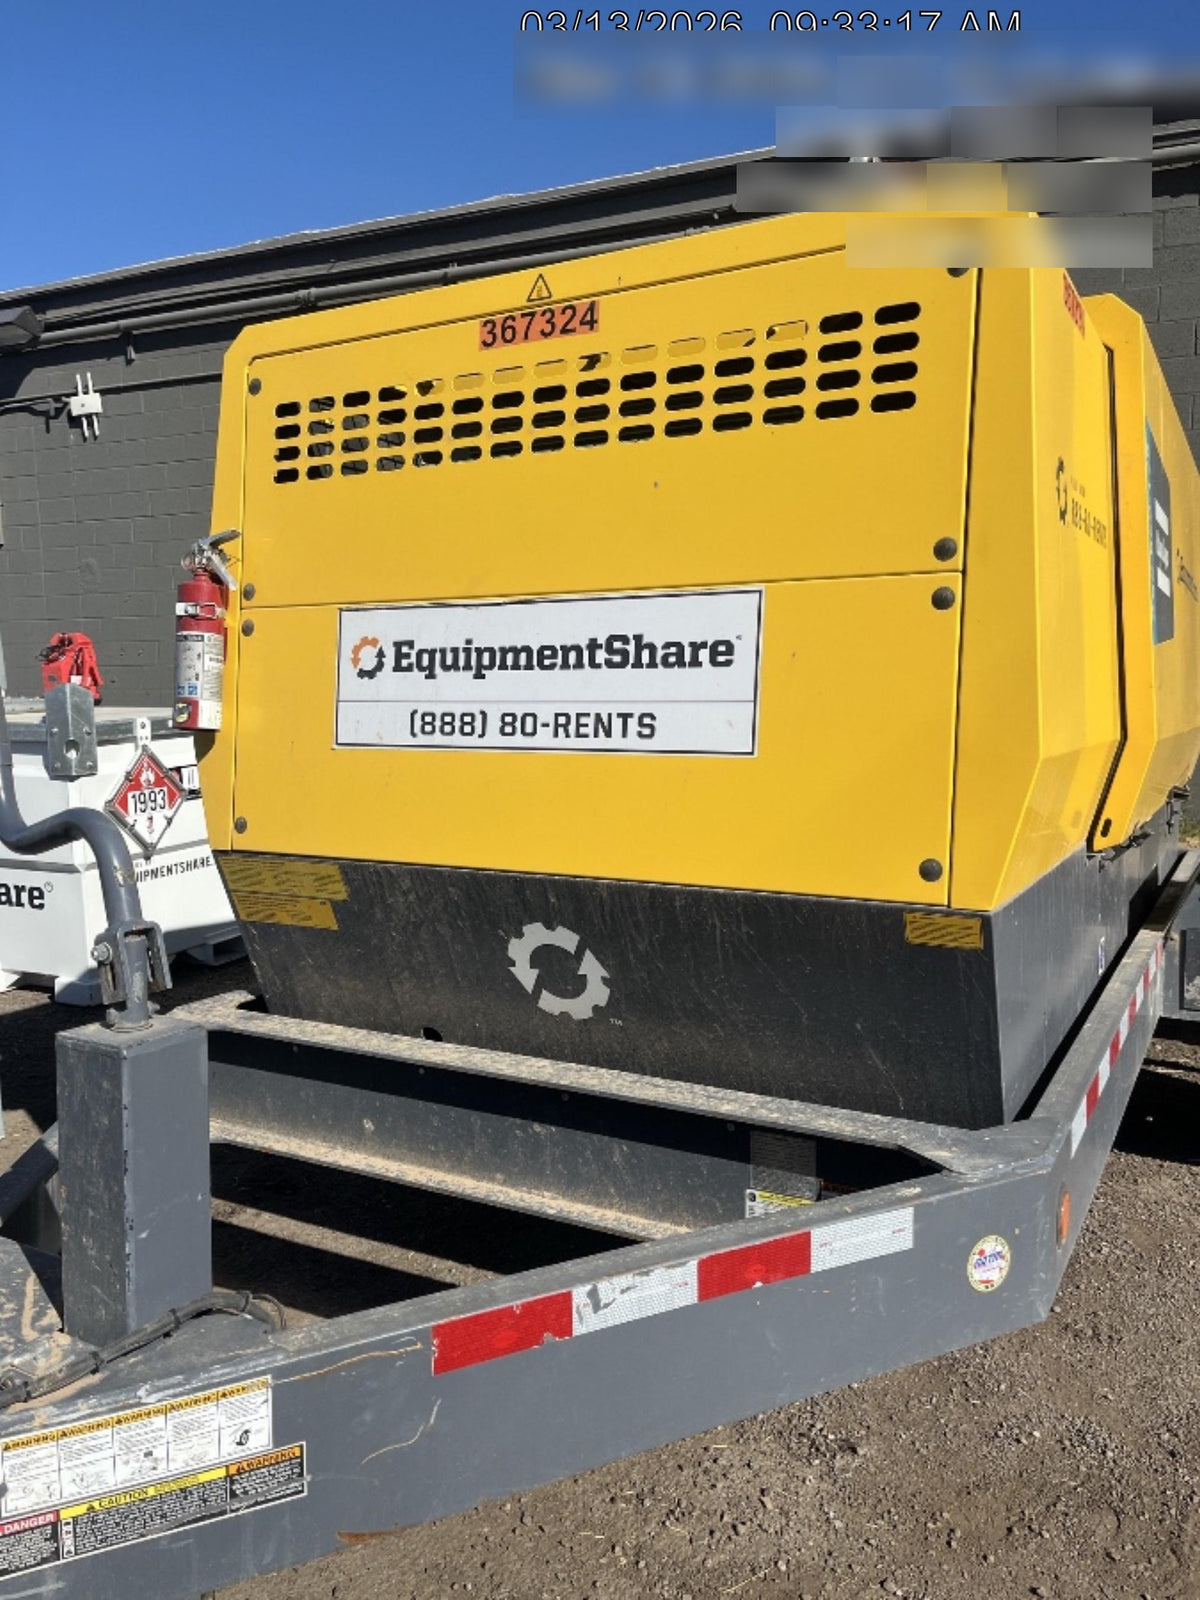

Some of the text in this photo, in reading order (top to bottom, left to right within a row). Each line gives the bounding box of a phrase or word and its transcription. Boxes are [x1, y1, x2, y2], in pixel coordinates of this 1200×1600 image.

[480, 300, 598, 348] 367324
[392, 633, 736, 680] EquipmentShare
[409, 709, 657, 739] (888) 80-RENTS
[130, 788, 166, 814] 1993
[99, 1488, 149, 1508] CAUTION
[4, 1513, 55, 1534] DANGER
